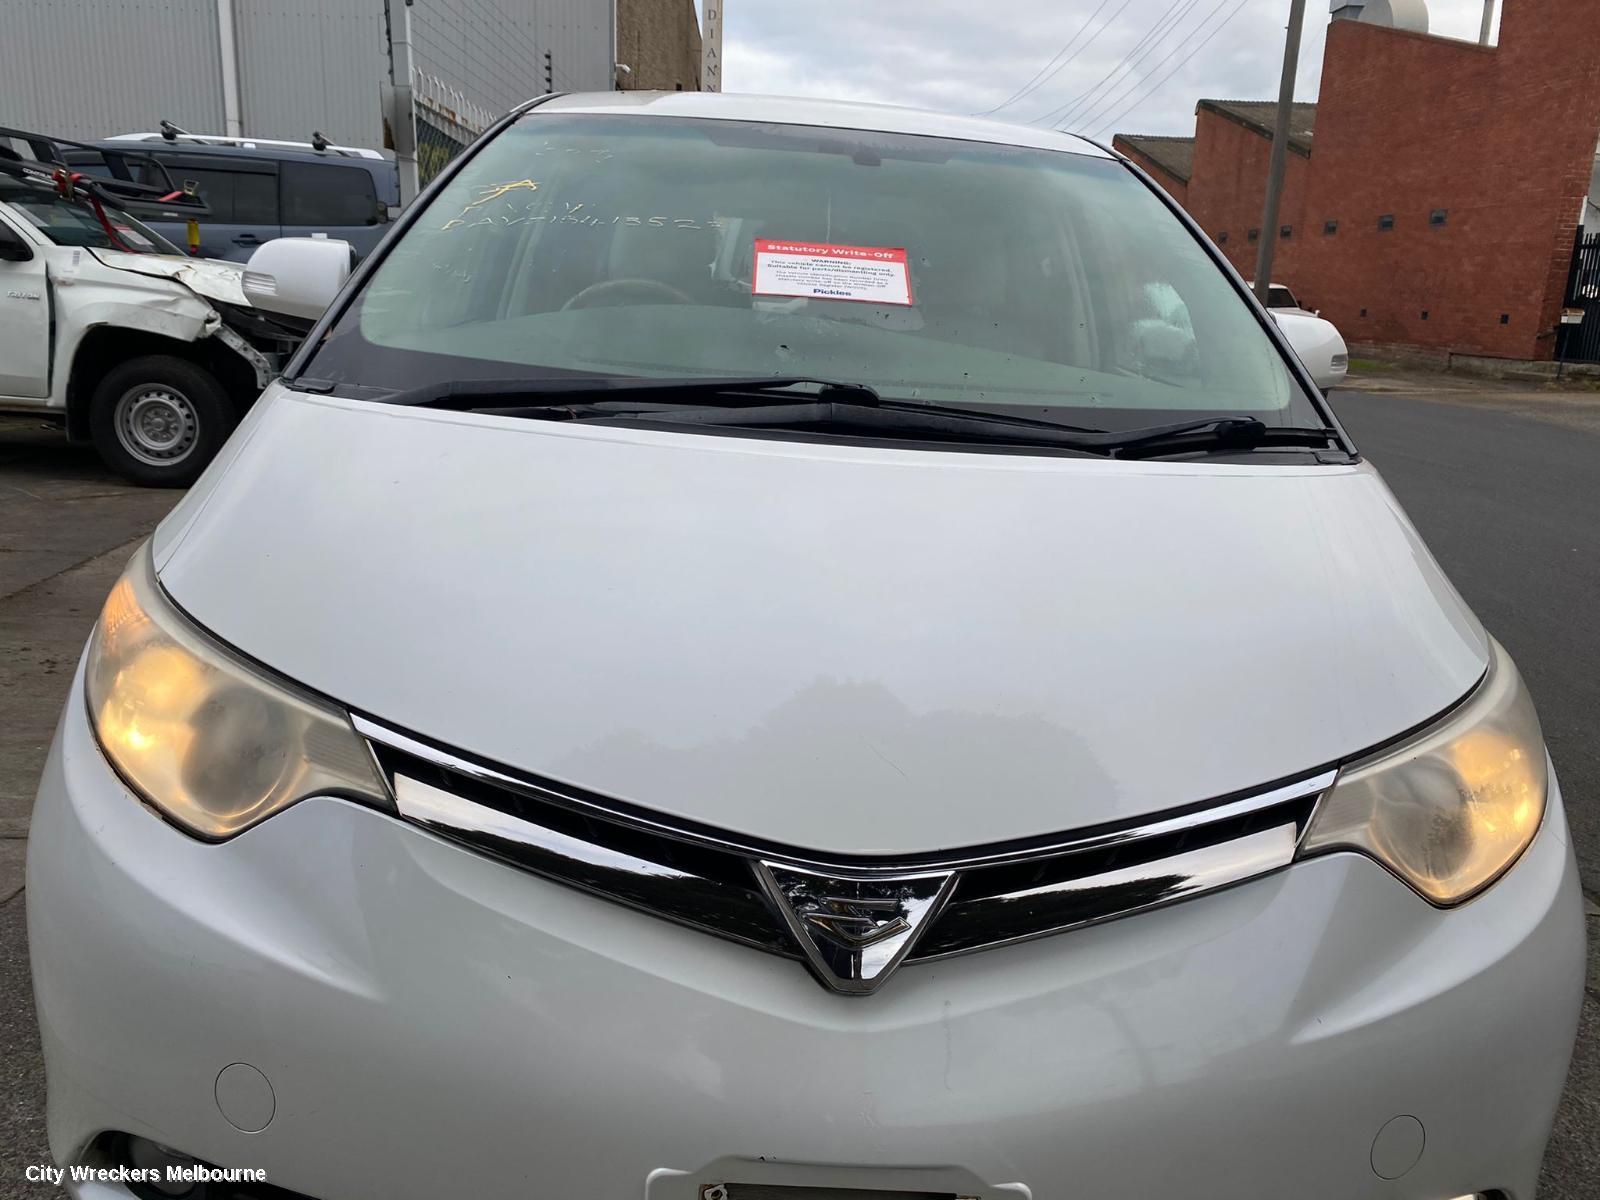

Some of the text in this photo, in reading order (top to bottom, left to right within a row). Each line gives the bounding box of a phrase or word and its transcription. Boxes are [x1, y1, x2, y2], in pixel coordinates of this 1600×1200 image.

[767, 244, 893, 258] Statutory Write-Off
[813, 288, 851, 296] Pickles
